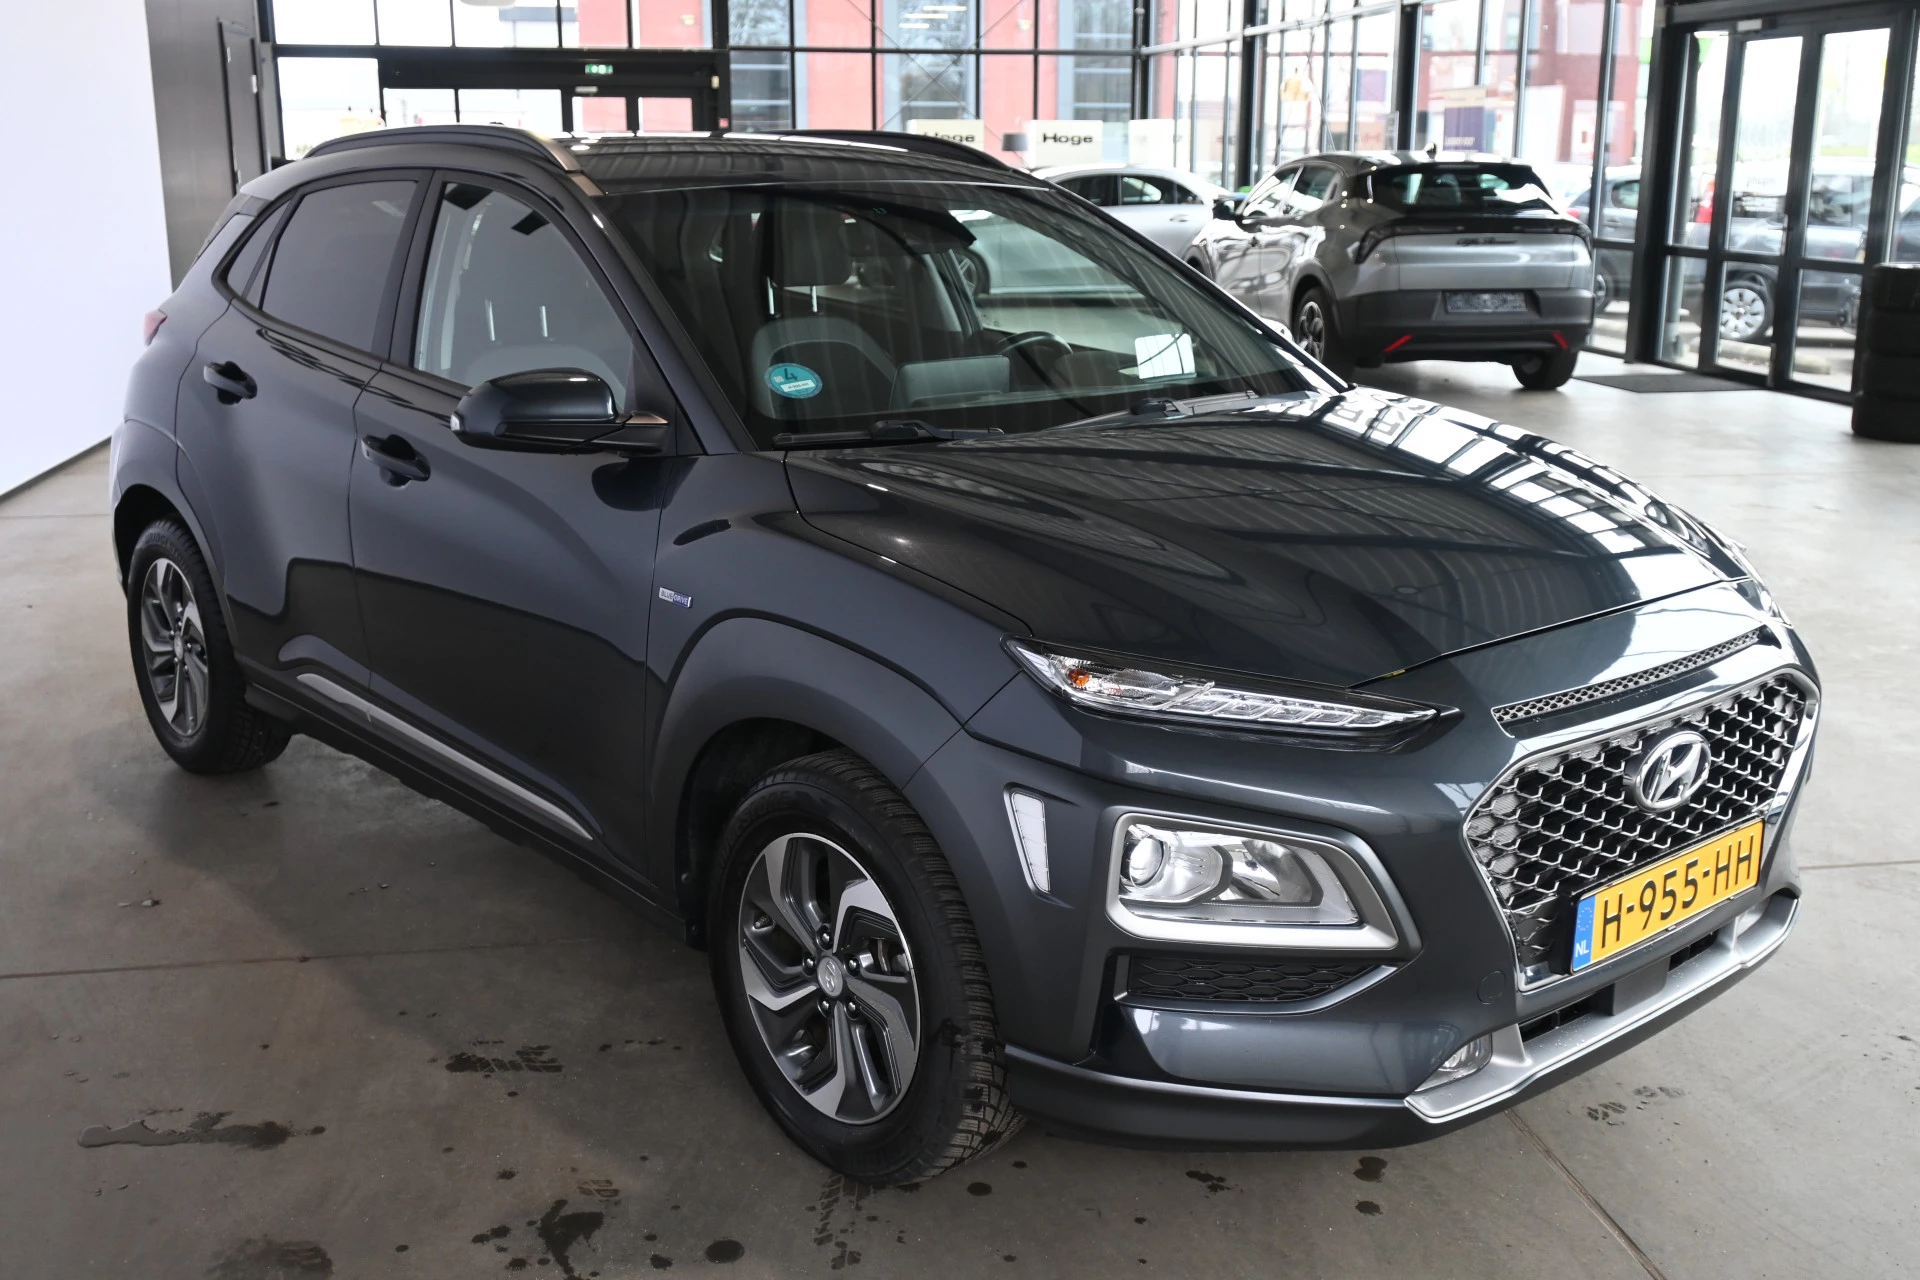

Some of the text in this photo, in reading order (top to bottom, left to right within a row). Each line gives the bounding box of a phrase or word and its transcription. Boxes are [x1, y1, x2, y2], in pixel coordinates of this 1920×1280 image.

[1043, 132, 1093, 145] Hoge
[1601, 834, 1754, 949] H-955-HH
[1575, 940, 1590, 958] NL
